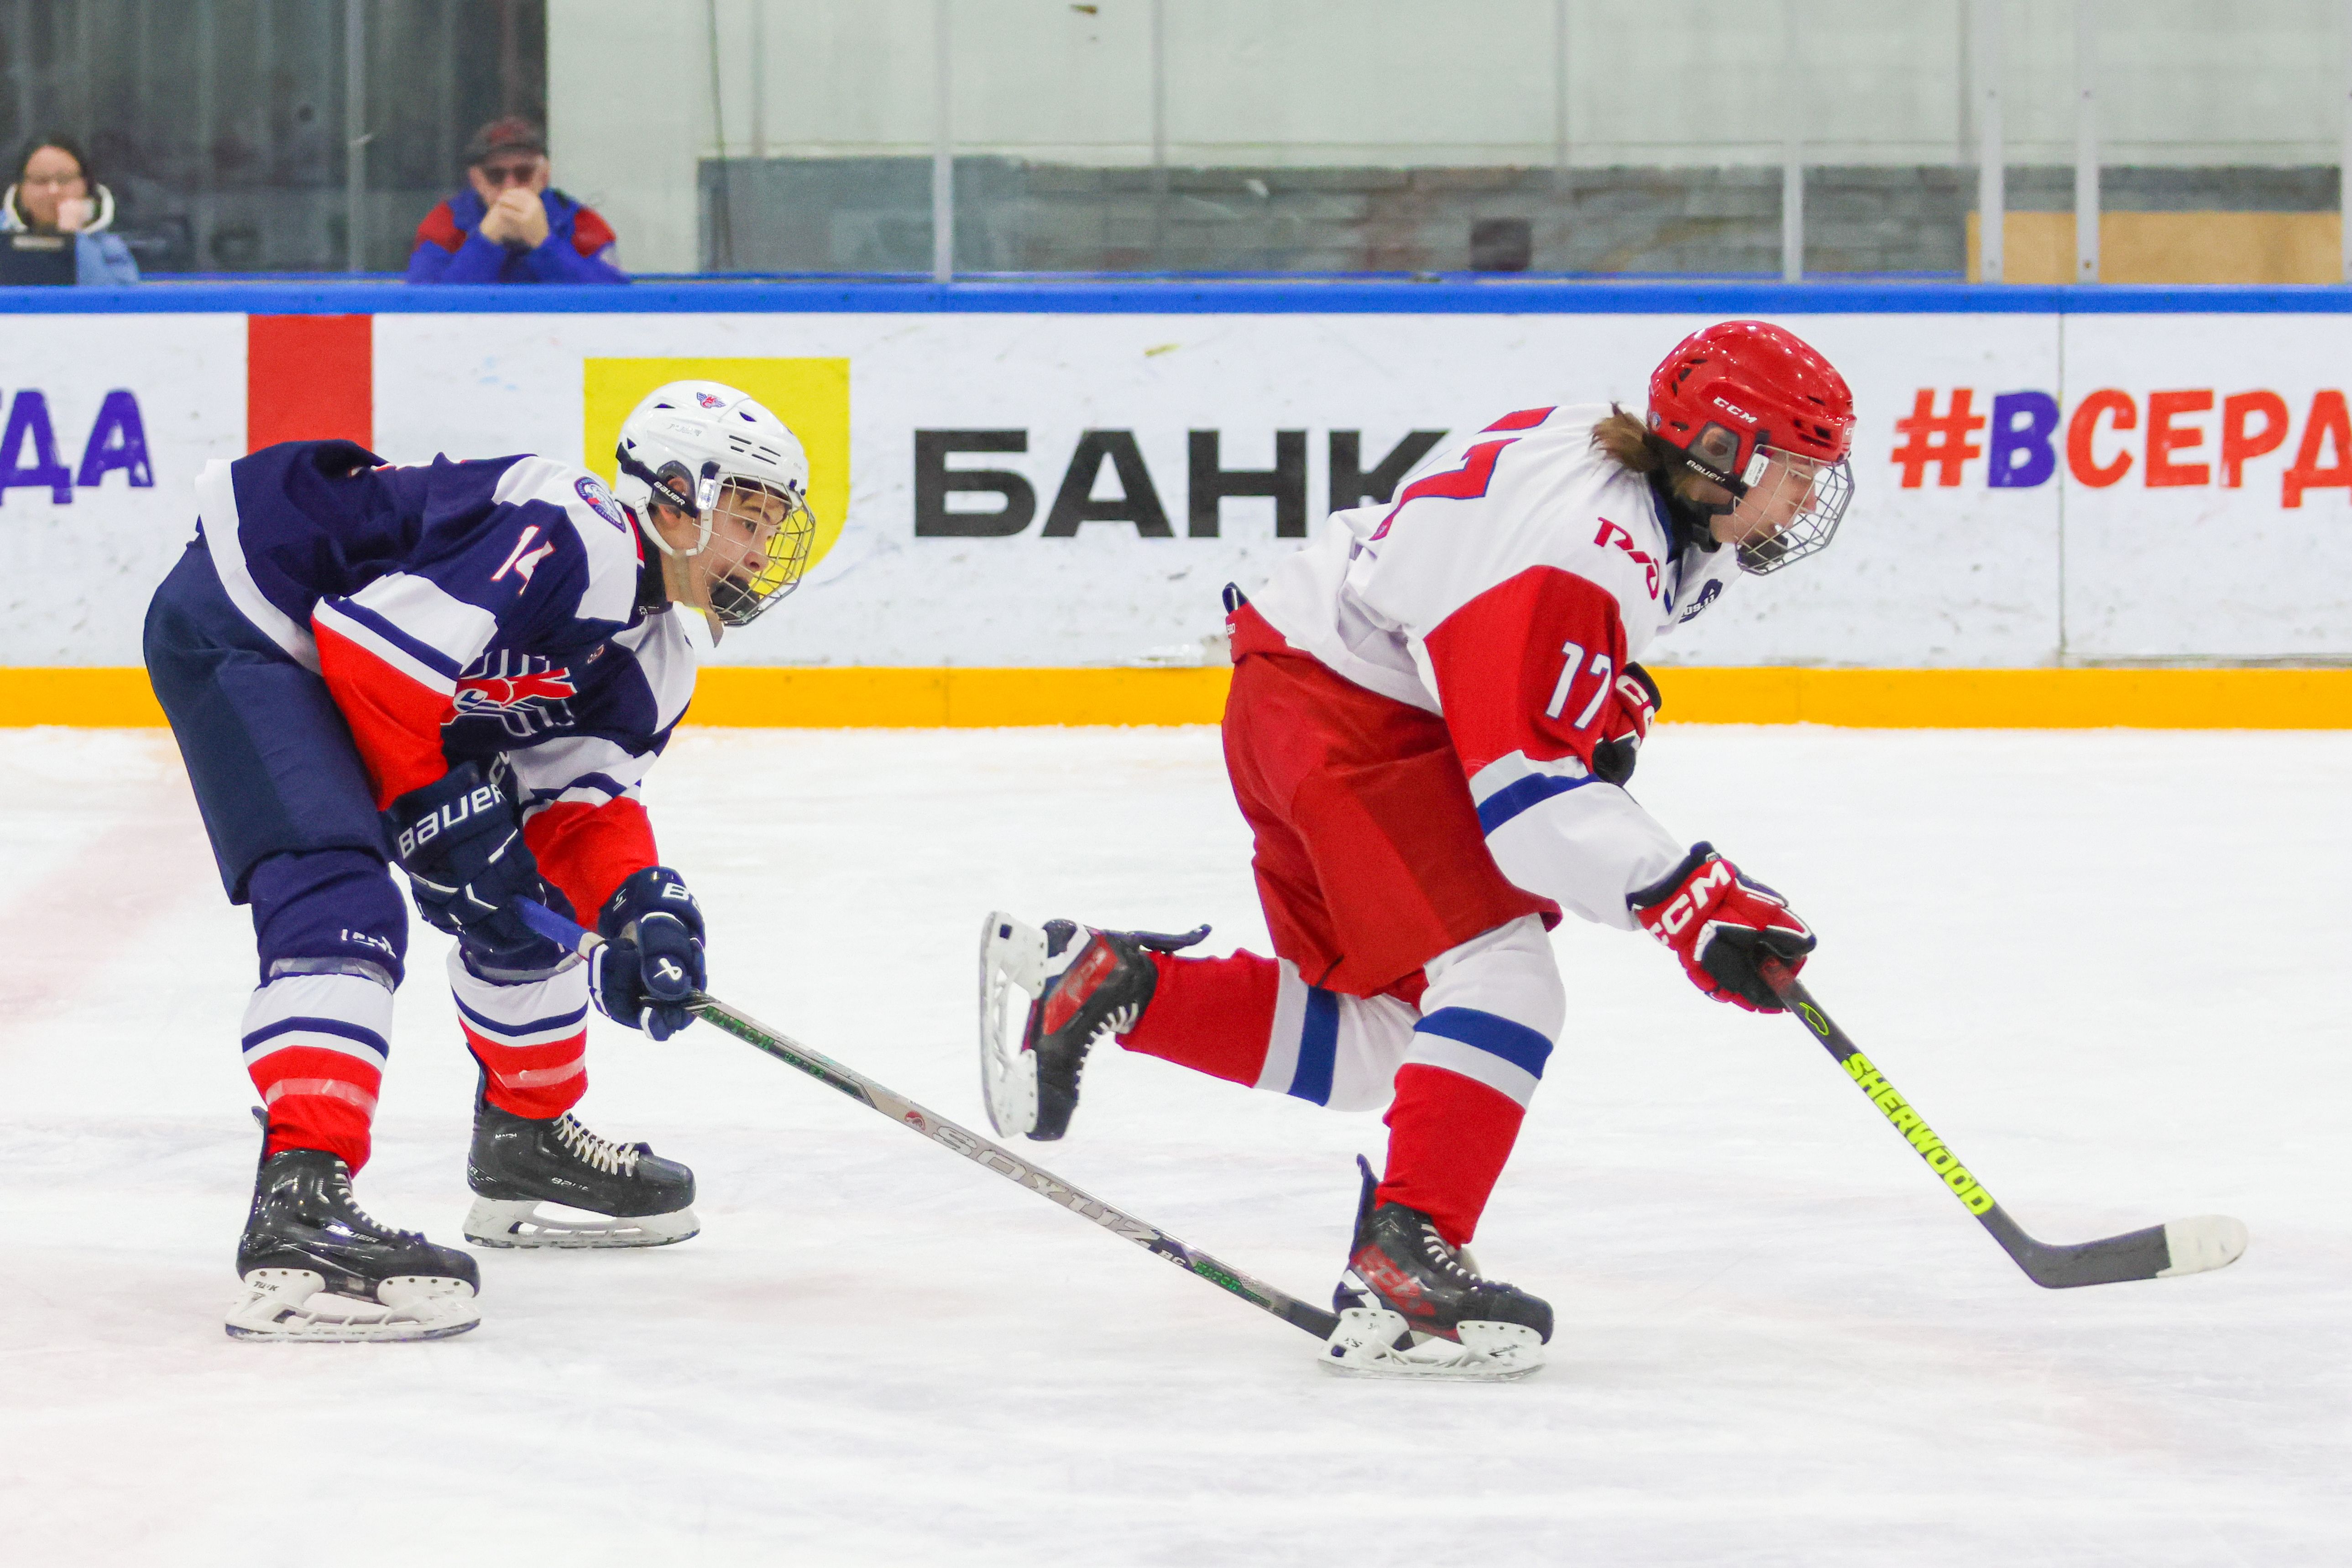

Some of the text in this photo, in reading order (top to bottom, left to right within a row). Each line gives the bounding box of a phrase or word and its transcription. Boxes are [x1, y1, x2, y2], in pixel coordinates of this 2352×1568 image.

[0, 389, 154, 505] ДА
[1713, 396, 1758, 424] CCM
[1891, 388, 2352, 509] #ВСЕРД
[914, 428, 1449, 538] БАНК
[1545, 640, 1612, 731] 17
[932, 1125, 1161, 1249] SOYUZ
[1841, 1052, 1995, 1216] SHERWOOD
